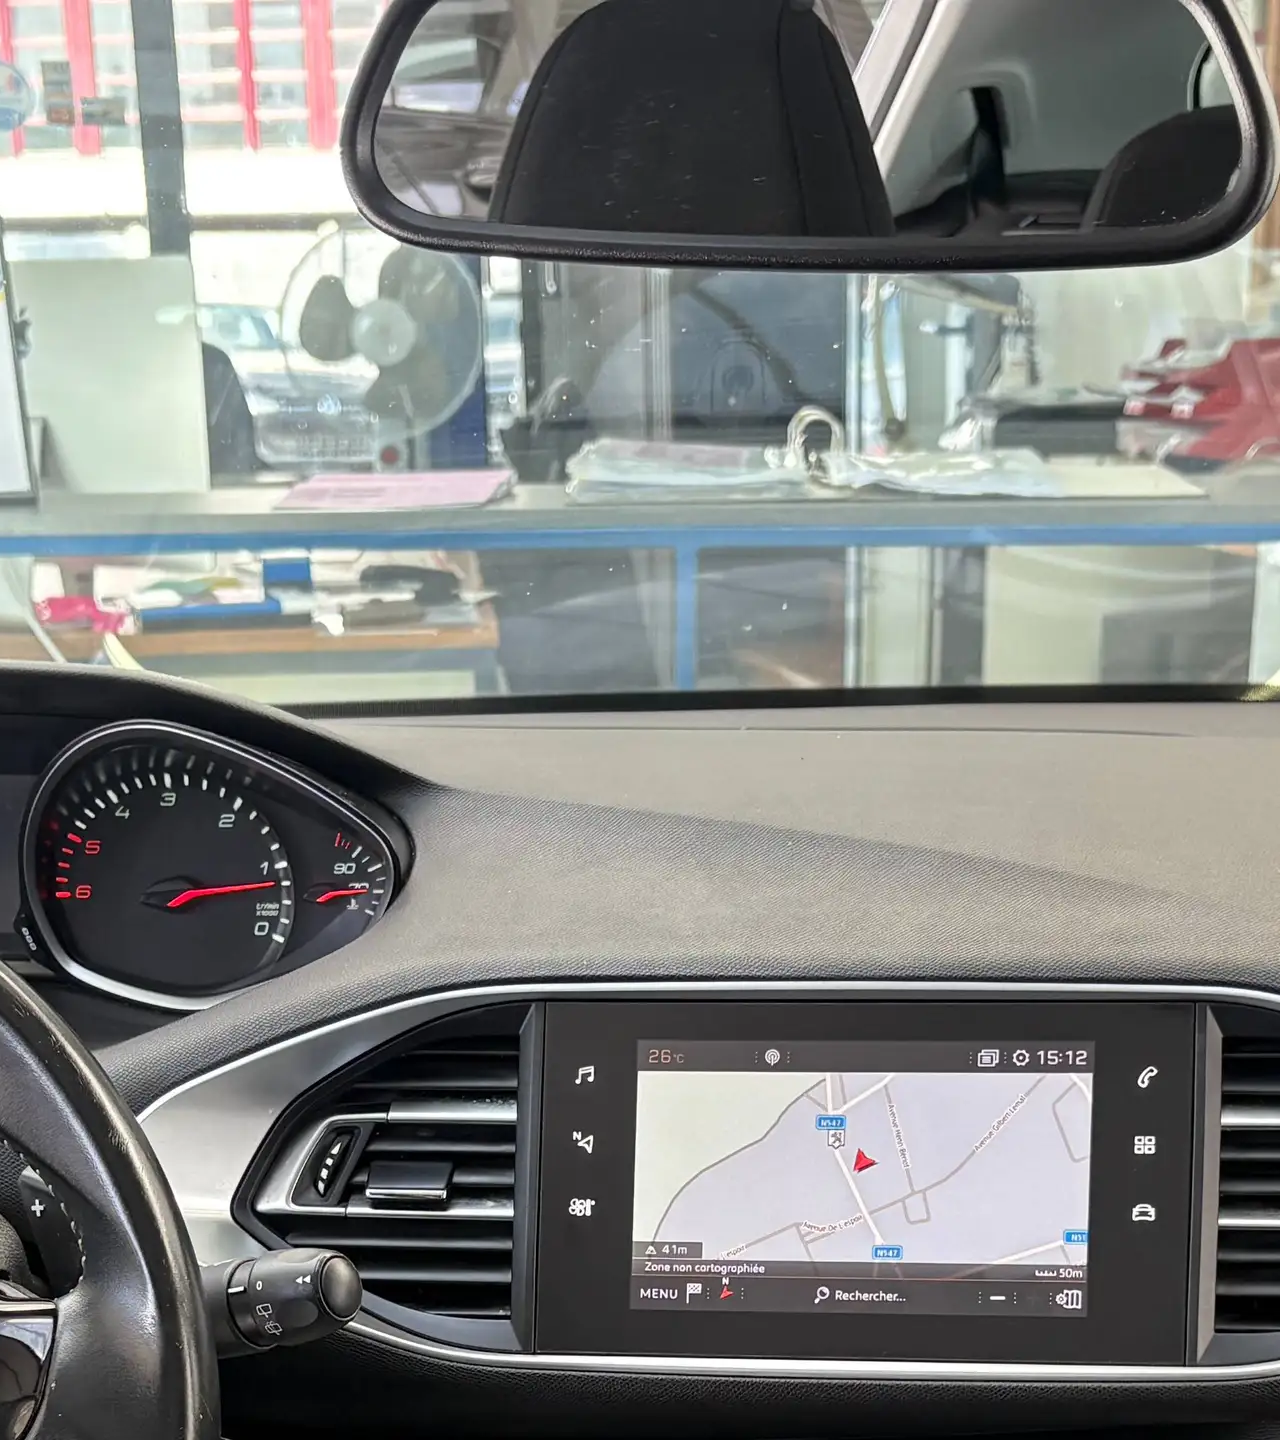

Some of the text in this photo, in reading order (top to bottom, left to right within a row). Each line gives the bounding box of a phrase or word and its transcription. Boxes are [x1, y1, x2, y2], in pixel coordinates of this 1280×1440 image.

[160, 792, 176, 806] 3
[115, 806, 130, 819] 4
[219, 814, 235, 827] 2
[85, 840, 101, 854] 5
[260, 862, 269, 875] 1
[333, 863, 356, 874] 90
[75, 885, 92, 899] 6
[254, 922, 269, 936] 0
[1037, 1050, 1087, 1065] 15:12
[888, 1104, 898, 1128] Avenue
[573, 1131, 582, 1140] N
[974, 1131, 994, 1151] Avenue
[993, 1111, 1010, 1132] Gilbert
[661, 1245, 688, 1255] 41m
[644, 1262, 765, 1275] Zone non cartographiée
[1059, 1268, 1083, 1278] 50m
[640, 1289, 678, 1299] MENU
[835, 1290, 906, 1302] Rechercher...
